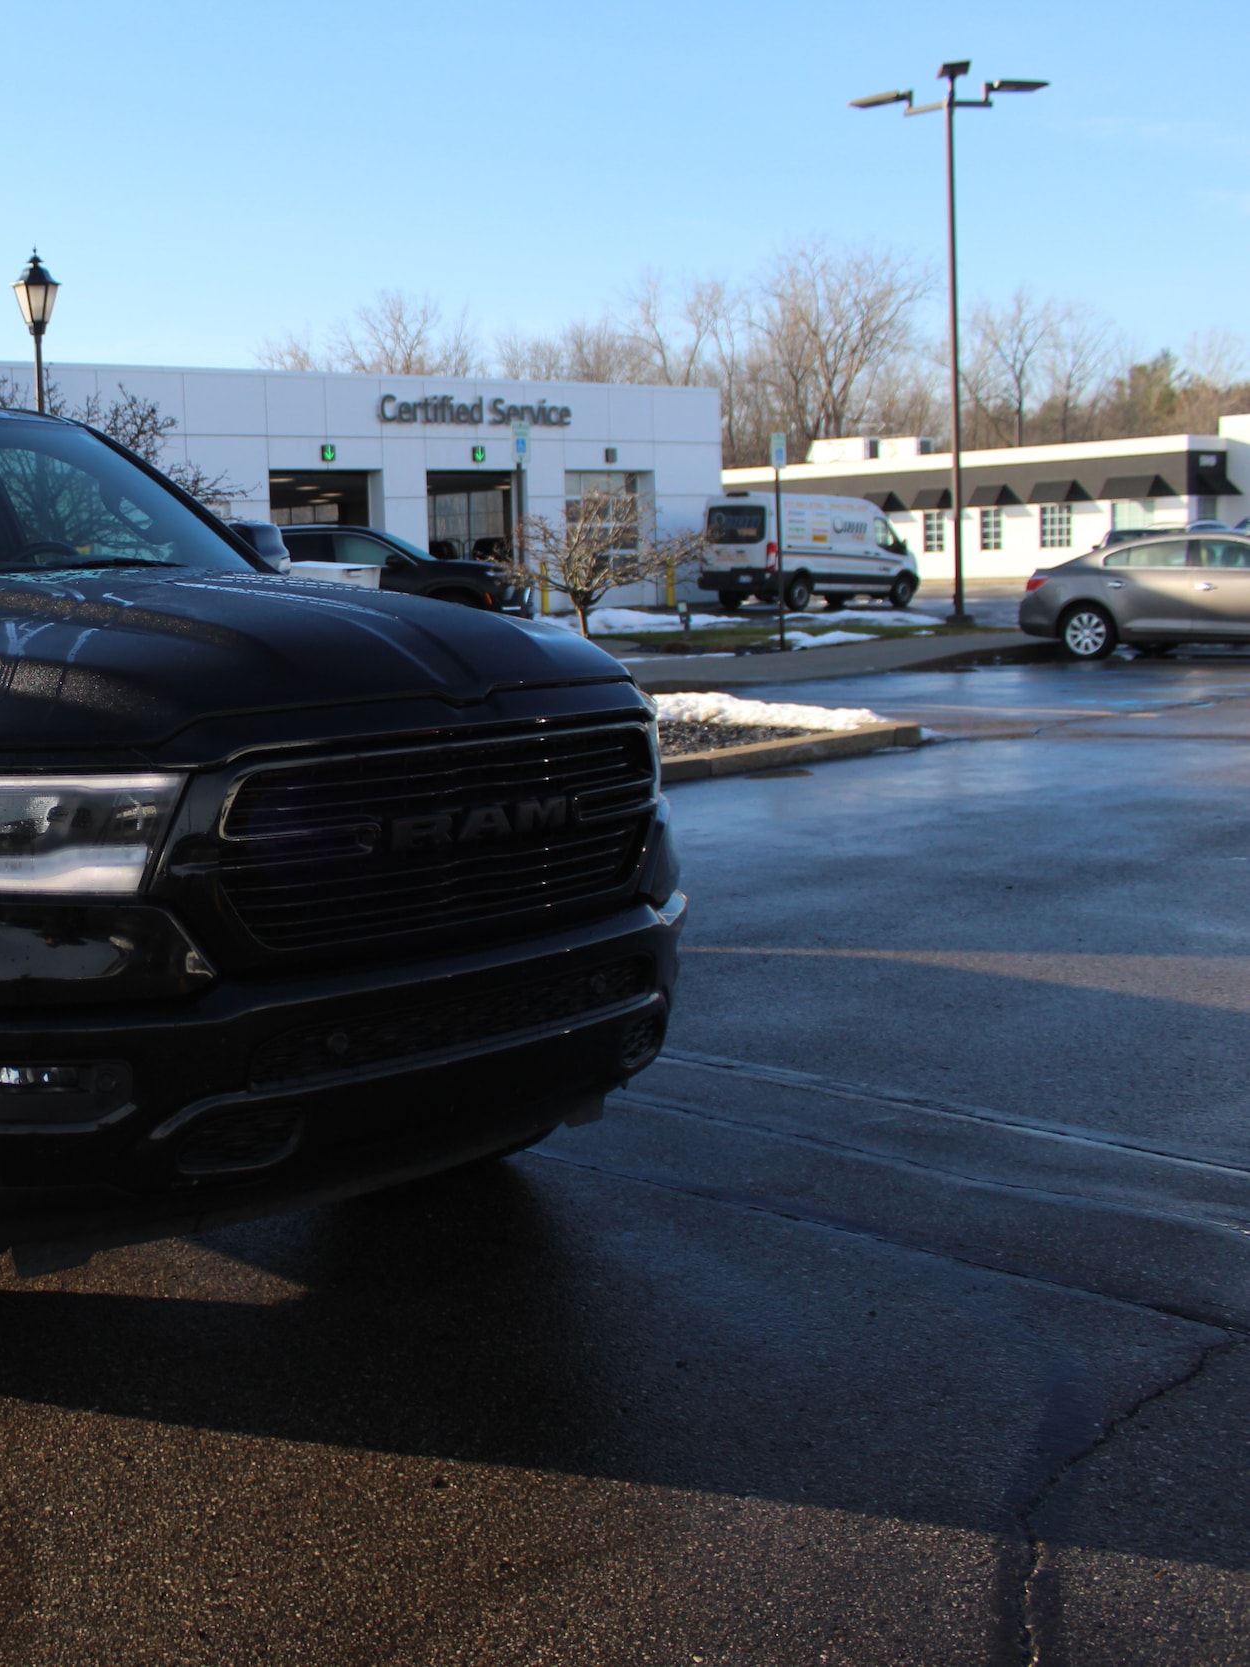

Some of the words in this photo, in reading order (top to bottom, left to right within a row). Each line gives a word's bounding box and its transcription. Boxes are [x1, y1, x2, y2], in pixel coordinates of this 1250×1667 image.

[379, 394, 484, 425] Certified
[489, 398, 572, 426] Service
[390, 795, 568, 851] RAM
